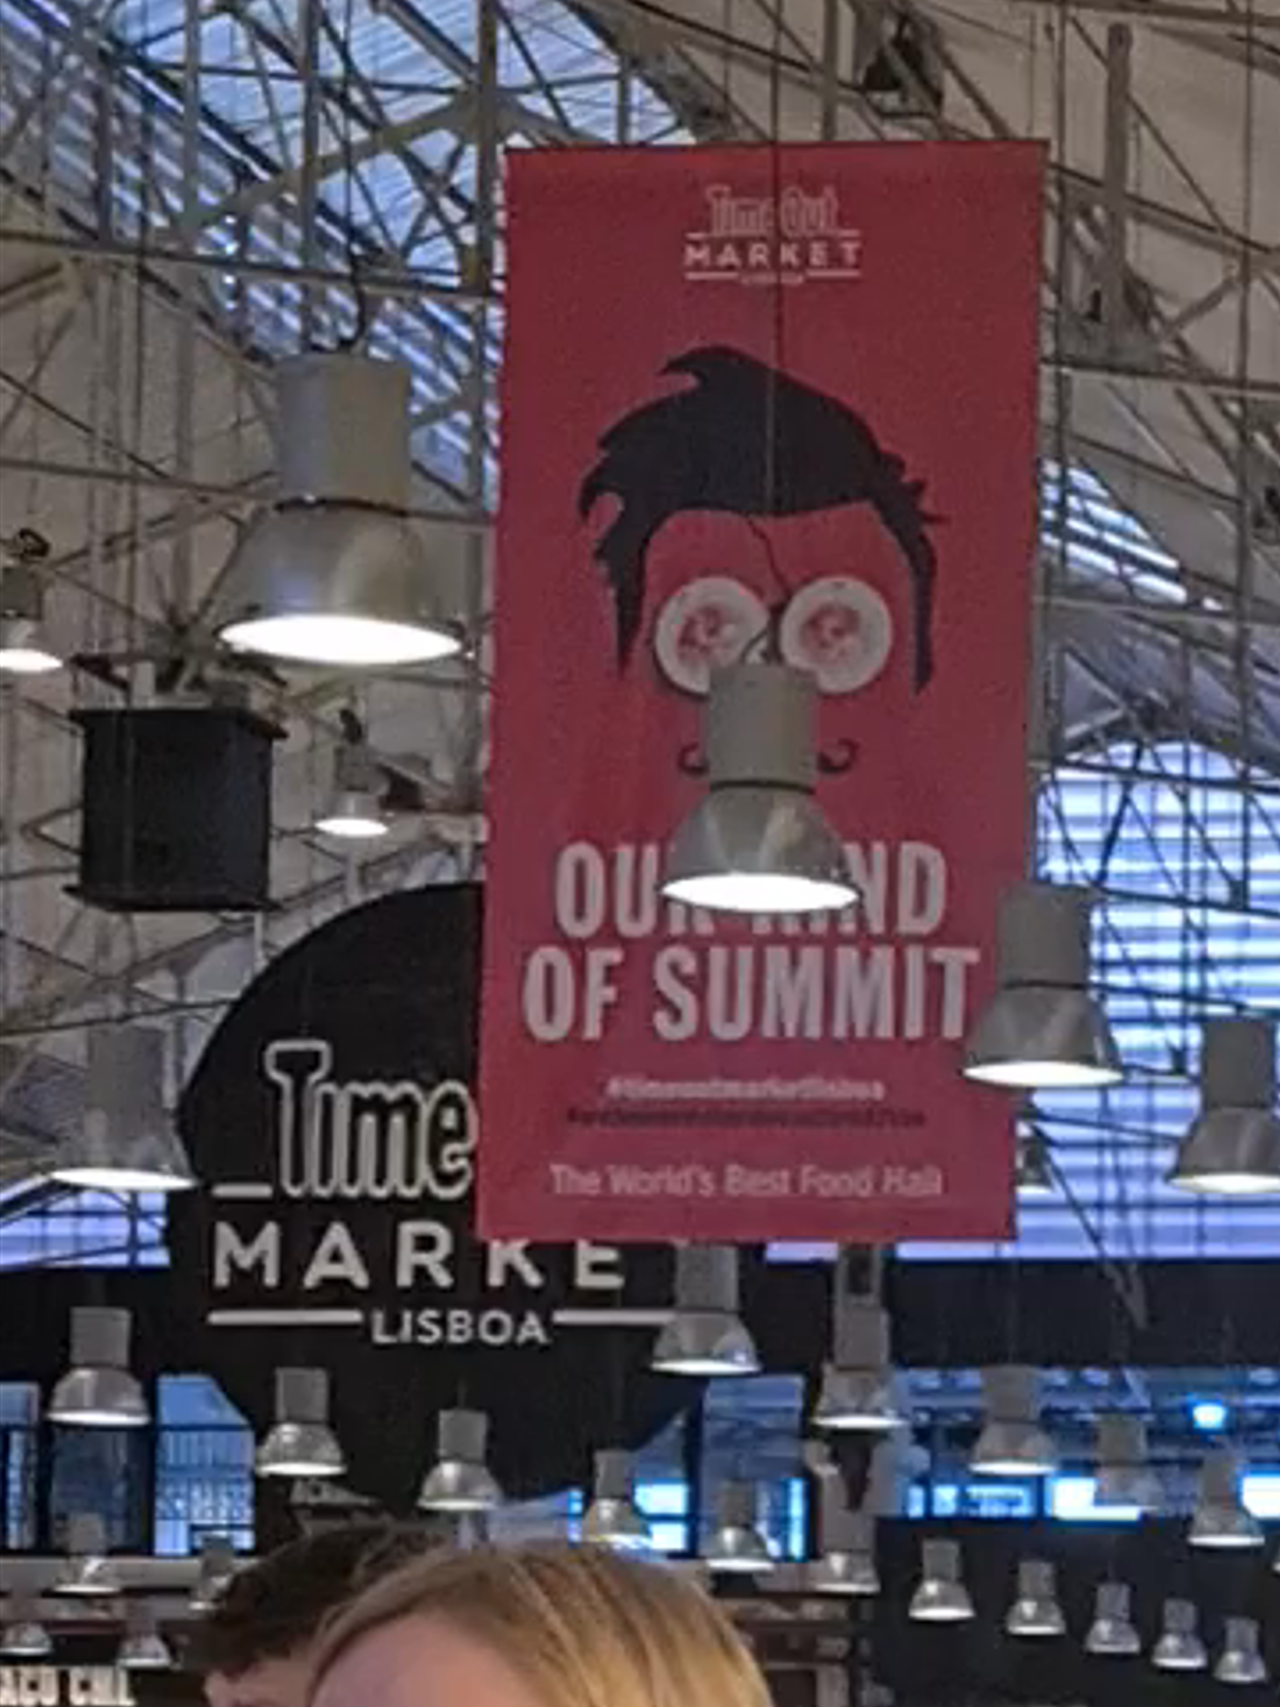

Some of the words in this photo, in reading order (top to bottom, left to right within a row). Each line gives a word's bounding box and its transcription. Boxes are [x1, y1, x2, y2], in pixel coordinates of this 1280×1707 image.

[683, 240, 862, 268] MARKET
[522, 944, 625, 1042] OF
[652, 944, 980, 1042] SUMMIT
[264, 1039, 478, 1197] Time
[550, 1164, 602, 1196] The
[607, 1164, 715, 1196] World's
[723, 1164, 791, 1196] Best
[798, 1164, 870, 1196] Food
[881, 1164, 943, 1196] Hall
[212, 1221, 626, 1288] MARKE
[370, 1308, 551, 1347] LISBOA
